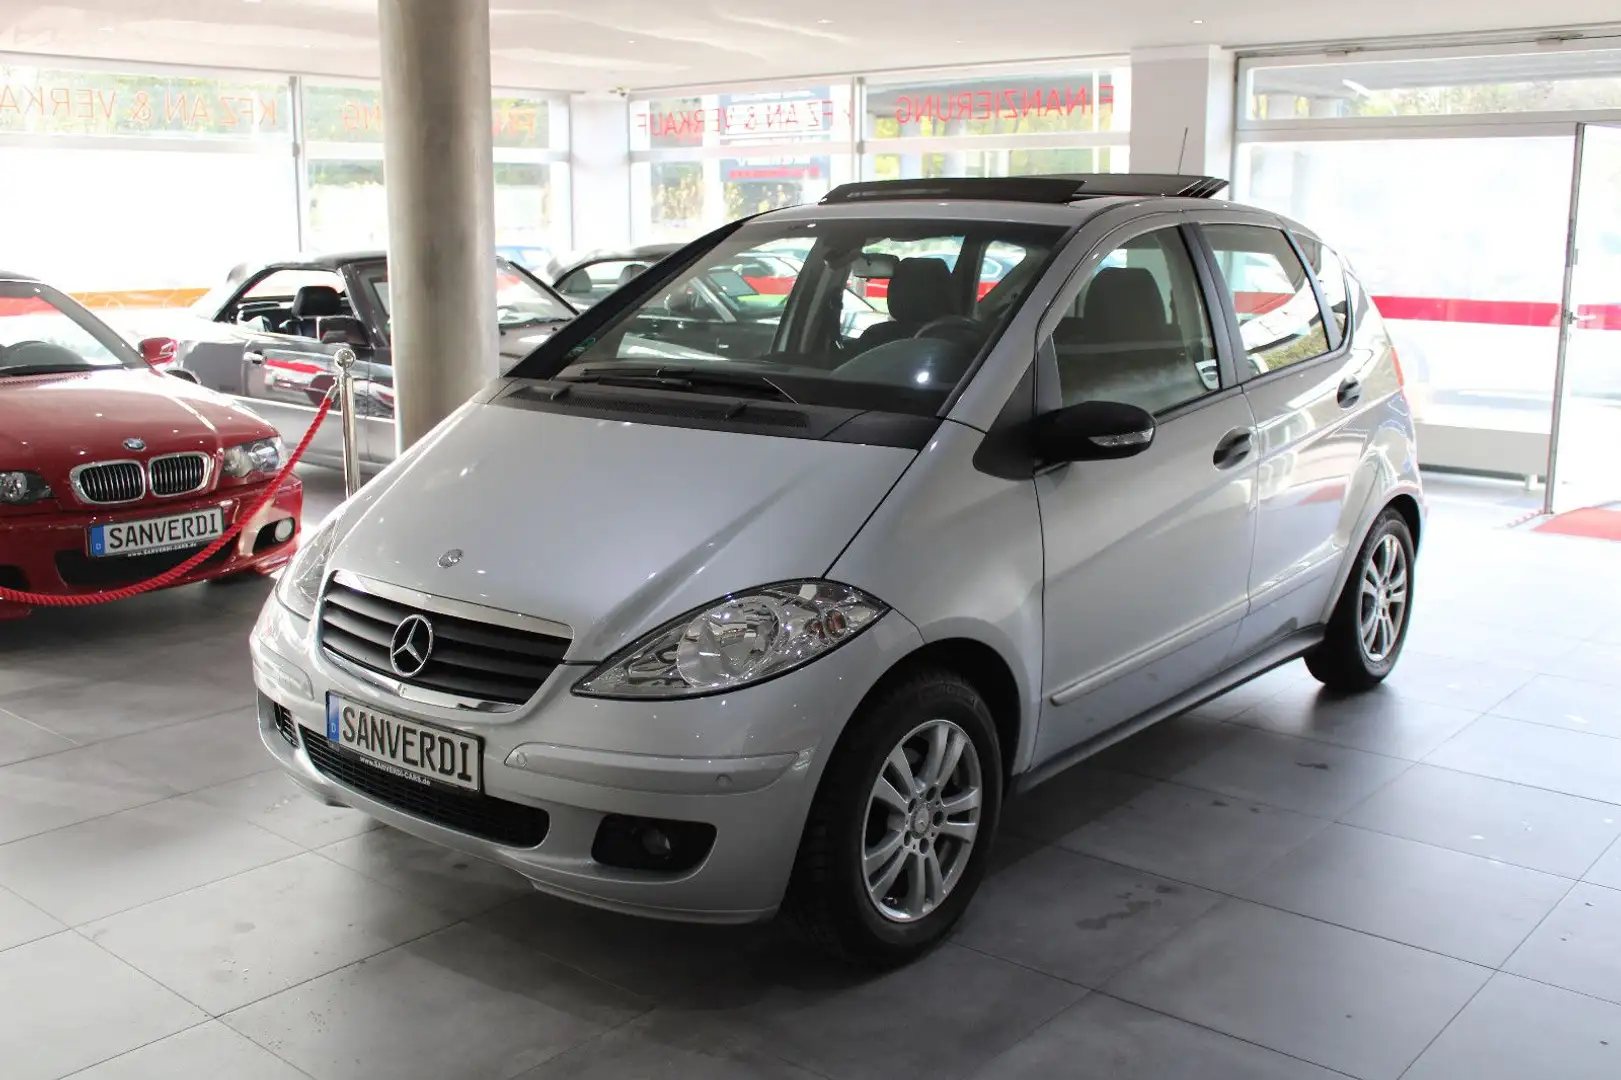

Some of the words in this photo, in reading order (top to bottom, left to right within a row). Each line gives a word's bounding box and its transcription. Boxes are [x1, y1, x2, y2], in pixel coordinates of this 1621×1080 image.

[109, 513, 219, 549] SANVERDI
[331, 723, 337, 734] D
[342, 706, 473, 783] SANVERDI
